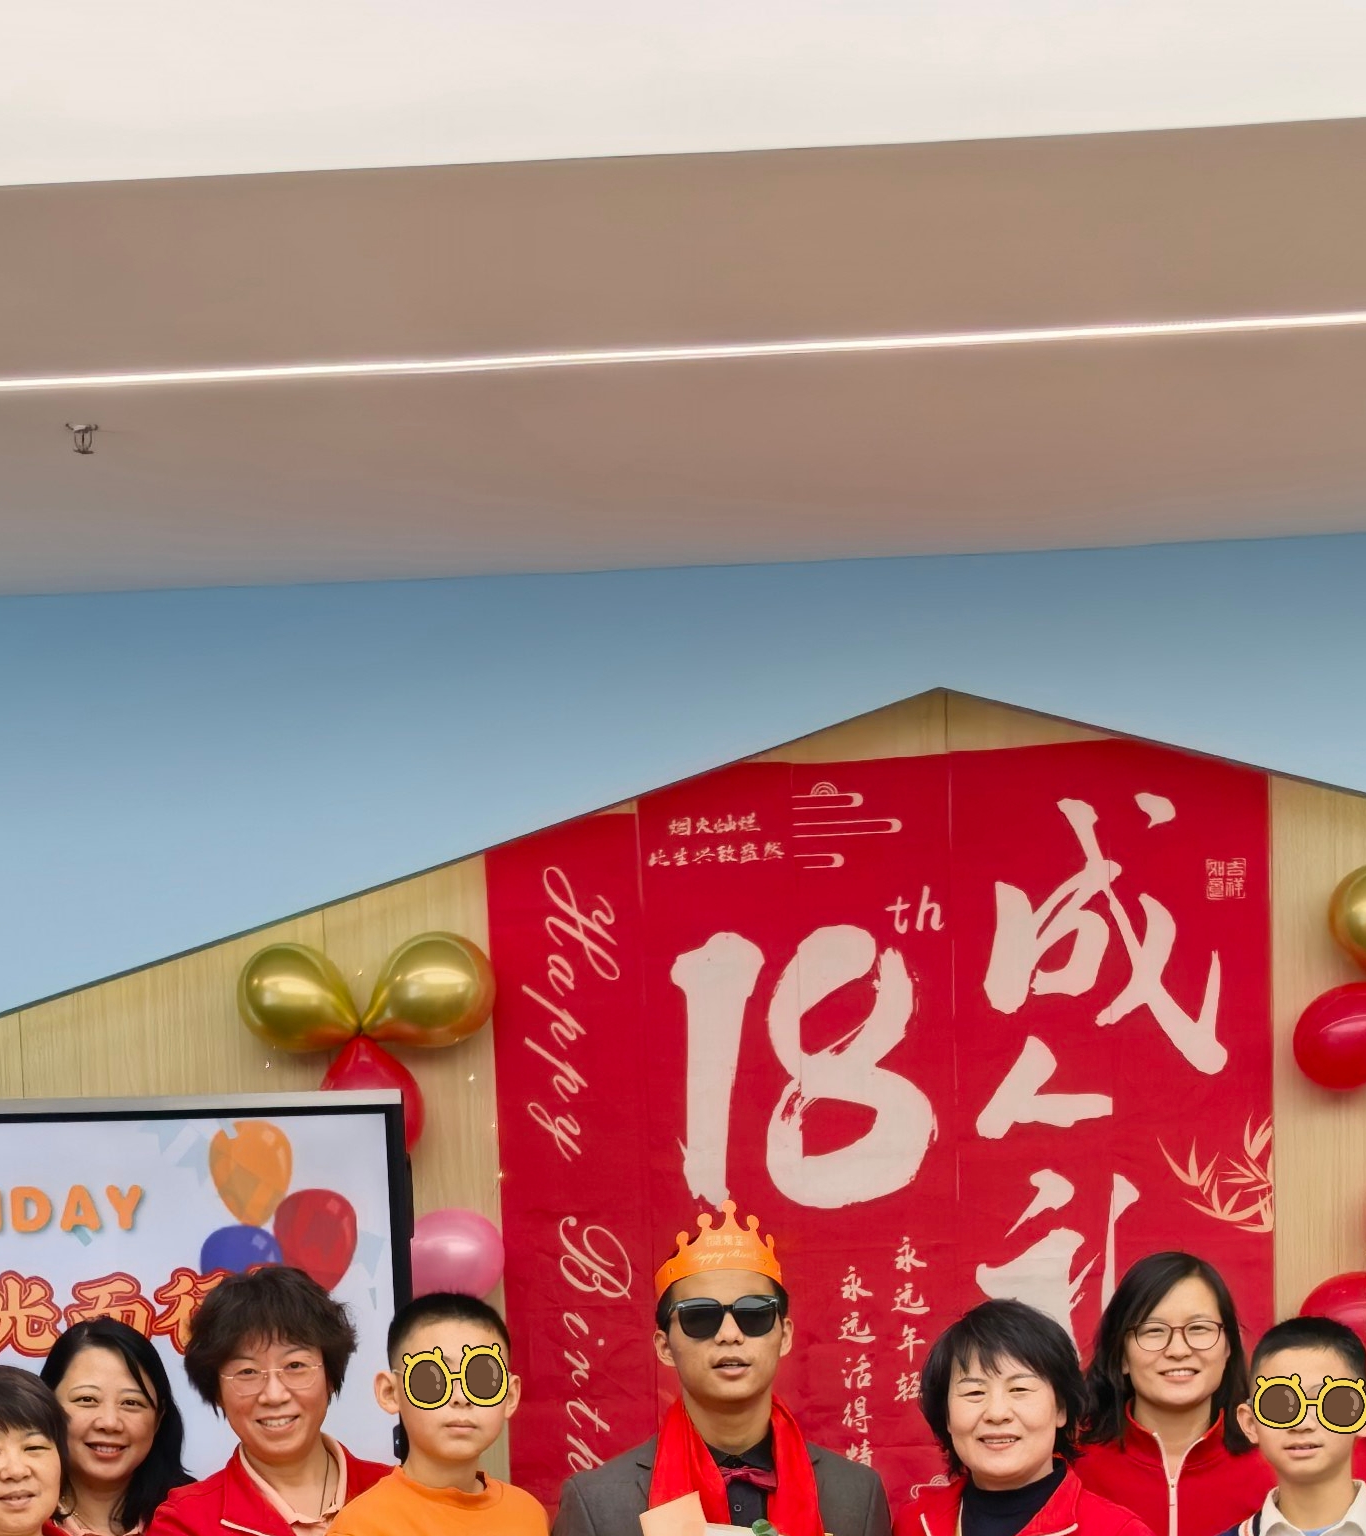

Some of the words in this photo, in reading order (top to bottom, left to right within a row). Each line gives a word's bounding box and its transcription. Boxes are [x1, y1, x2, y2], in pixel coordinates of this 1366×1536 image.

[667, 811, 762, 837] 烟火灿烂
[521, 864, 621, 1163] Happy
